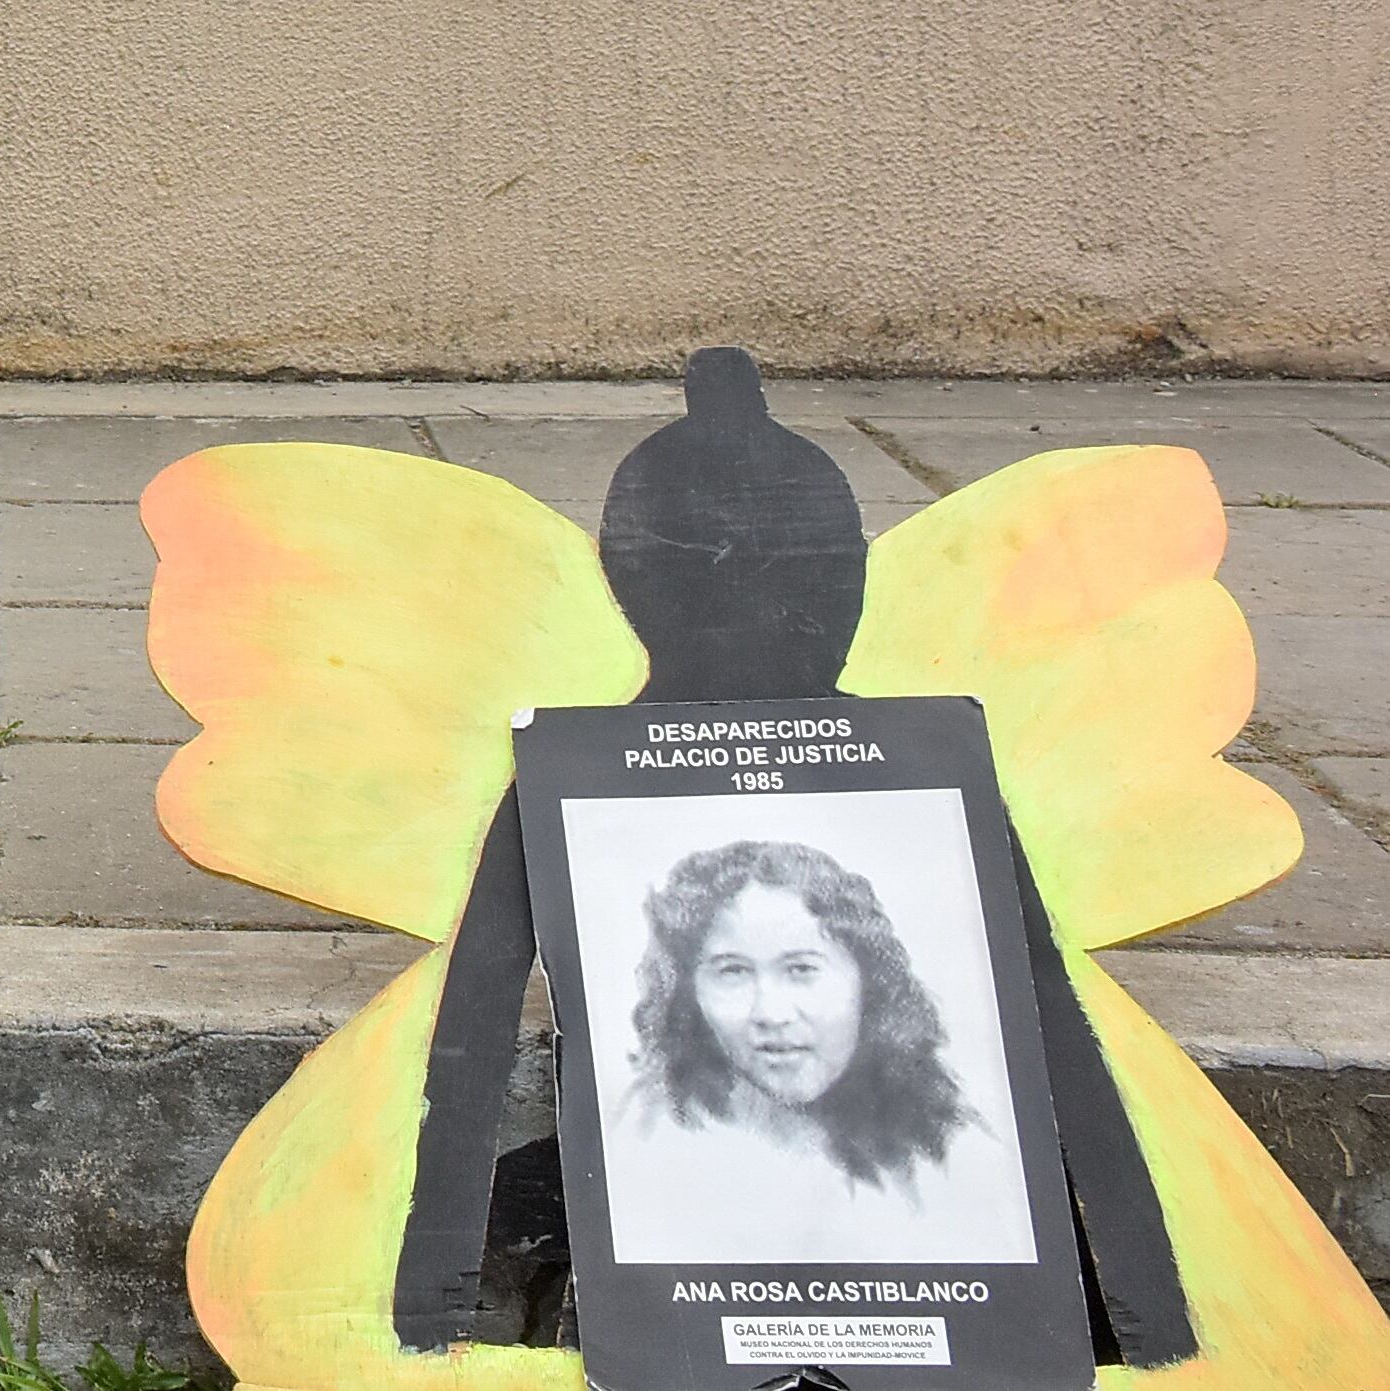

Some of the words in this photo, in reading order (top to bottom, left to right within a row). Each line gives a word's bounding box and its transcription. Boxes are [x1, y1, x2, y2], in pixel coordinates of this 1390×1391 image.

[647, 719, 852, 742] DESAPARECIDOS
[624, 748, 729, 768] PALACIO
[735, 746, 769, 765] DE
[775, 744, 885, 764] JUSTICIA
[730, 771, 783, 790] 1985
[672, 1281, 726, 1302] ANA
[730, 1281, 803, 1302] ROSA
[808, 1281, 988, 1302] CASTIBLANCO
[733, 1321, 804, 1336] GALERÍA
[807, 1323, 830, 1336] DE
[834, 1324, 855, 1336] LA
[858, 1323, 936, 1336] MEMORIA
